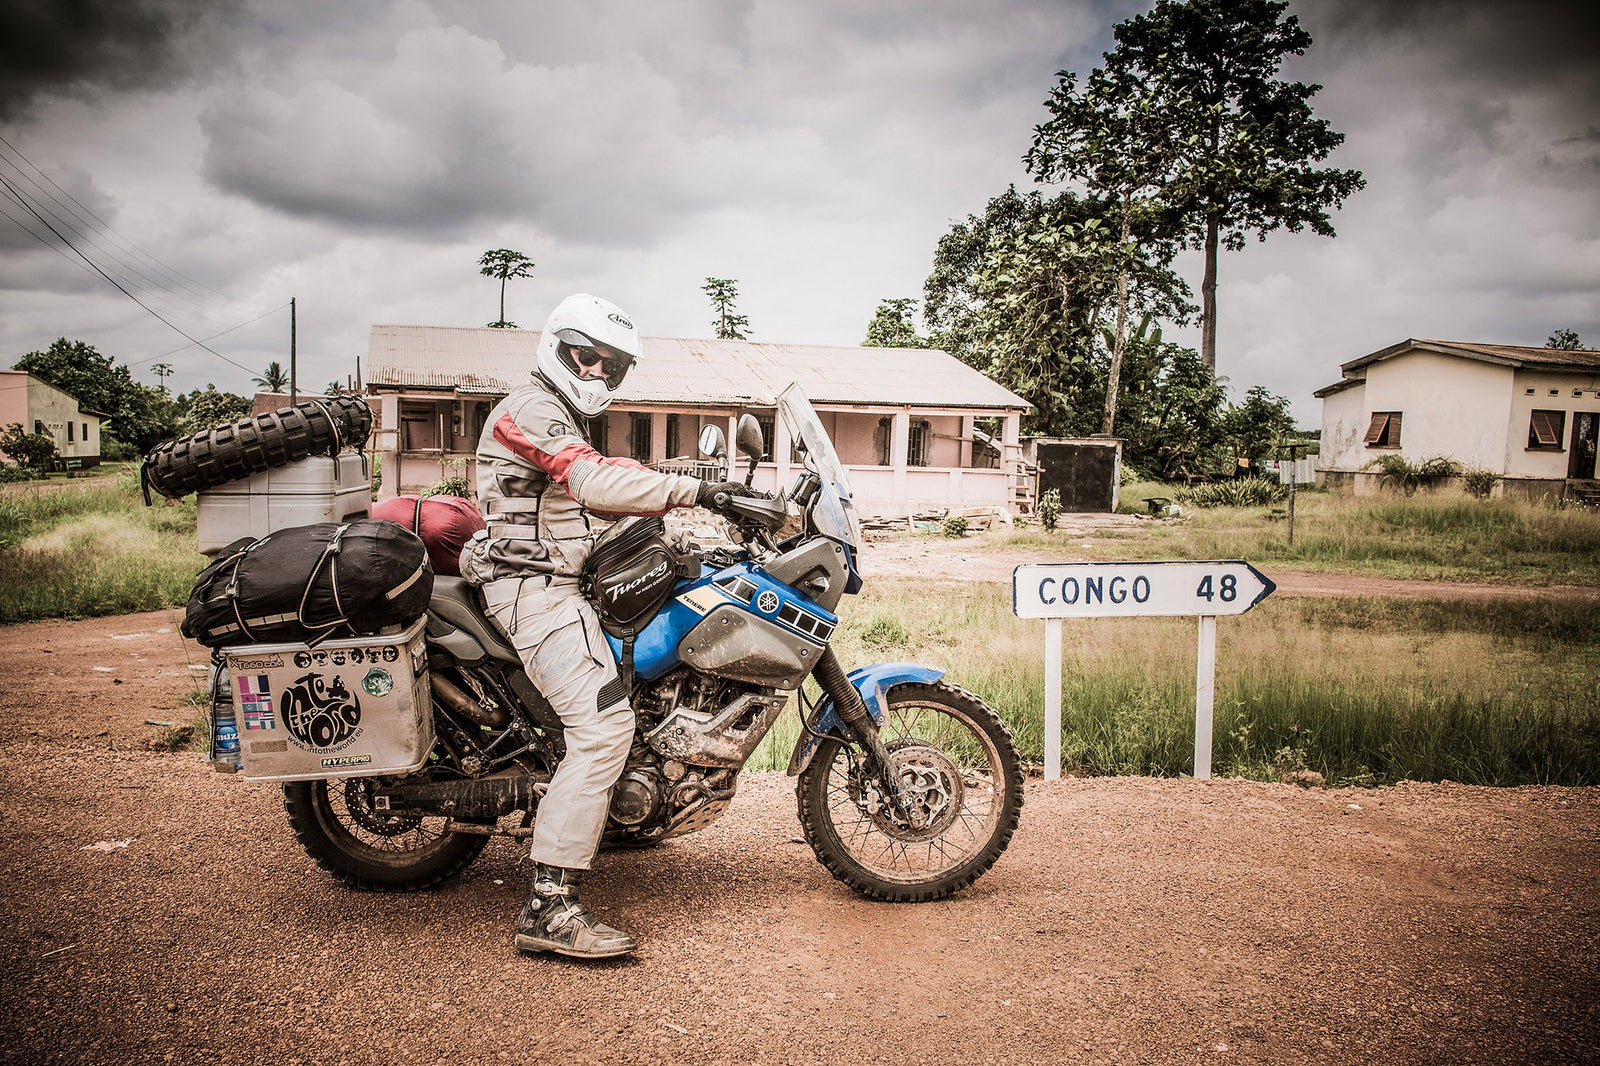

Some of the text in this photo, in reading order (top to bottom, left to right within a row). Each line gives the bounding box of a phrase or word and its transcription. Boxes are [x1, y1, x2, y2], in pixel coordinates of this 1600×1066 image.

[1038, 574, 1237, 605] CONGO 48
[287, 727, 364, 755] www.intotheworldeu
